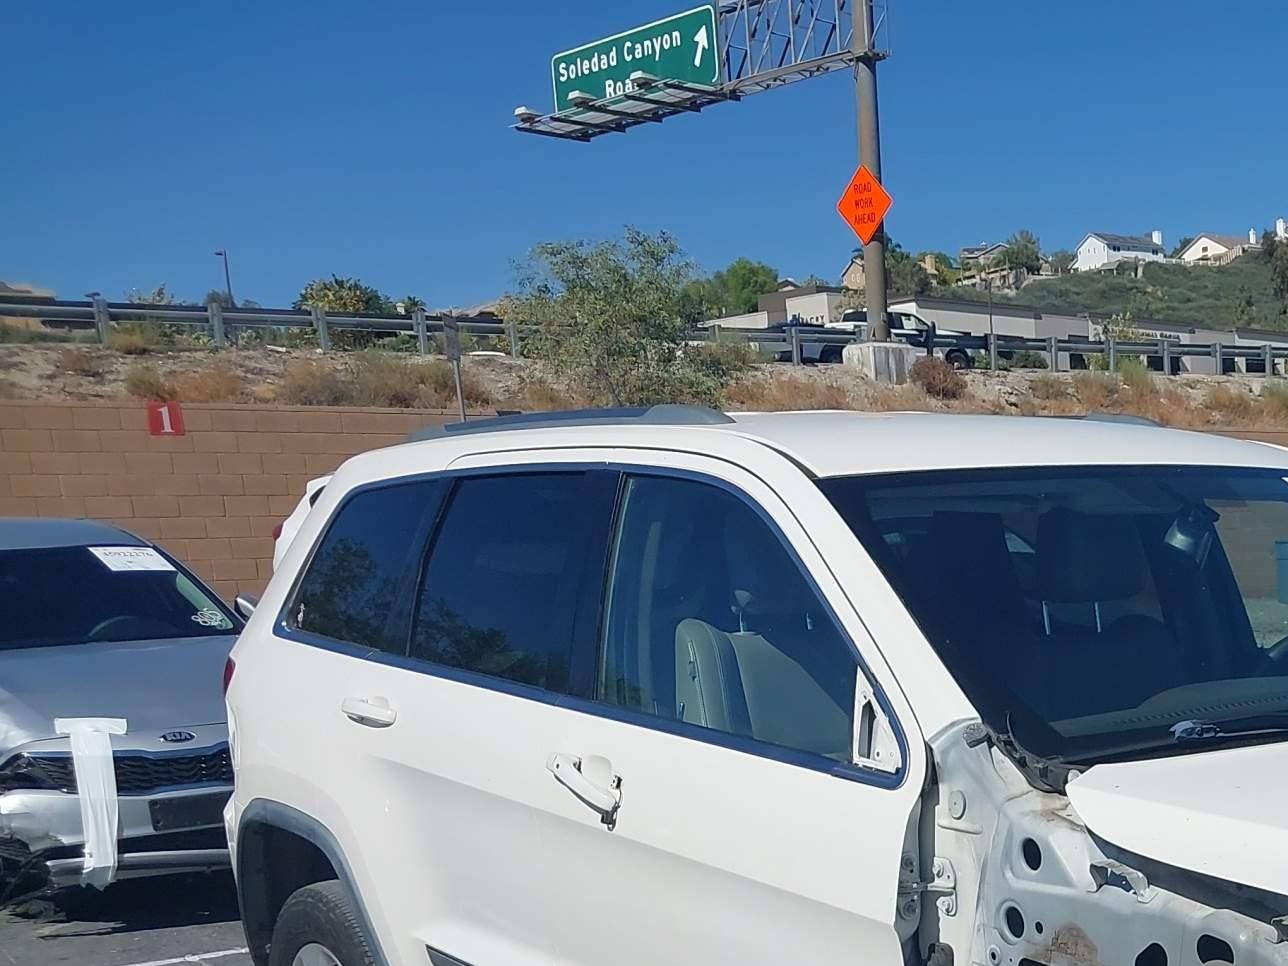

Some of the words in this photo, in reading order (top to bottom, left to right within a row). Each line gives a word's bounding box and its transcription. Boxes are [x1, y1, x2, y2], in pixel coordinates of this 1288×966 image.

[558, 46, 617, 82] Soledad
[623, 30, 681, 61] Canyon
[605, 77, 639, 98] Roa
[853, 182, 872, 194] ROAD
[854, 198, 873, 209] WORK
[854, 212, 876, 225] AHEAD
[156, 406, 175, 432] 1
[166, 732, 191, 741] KIA
